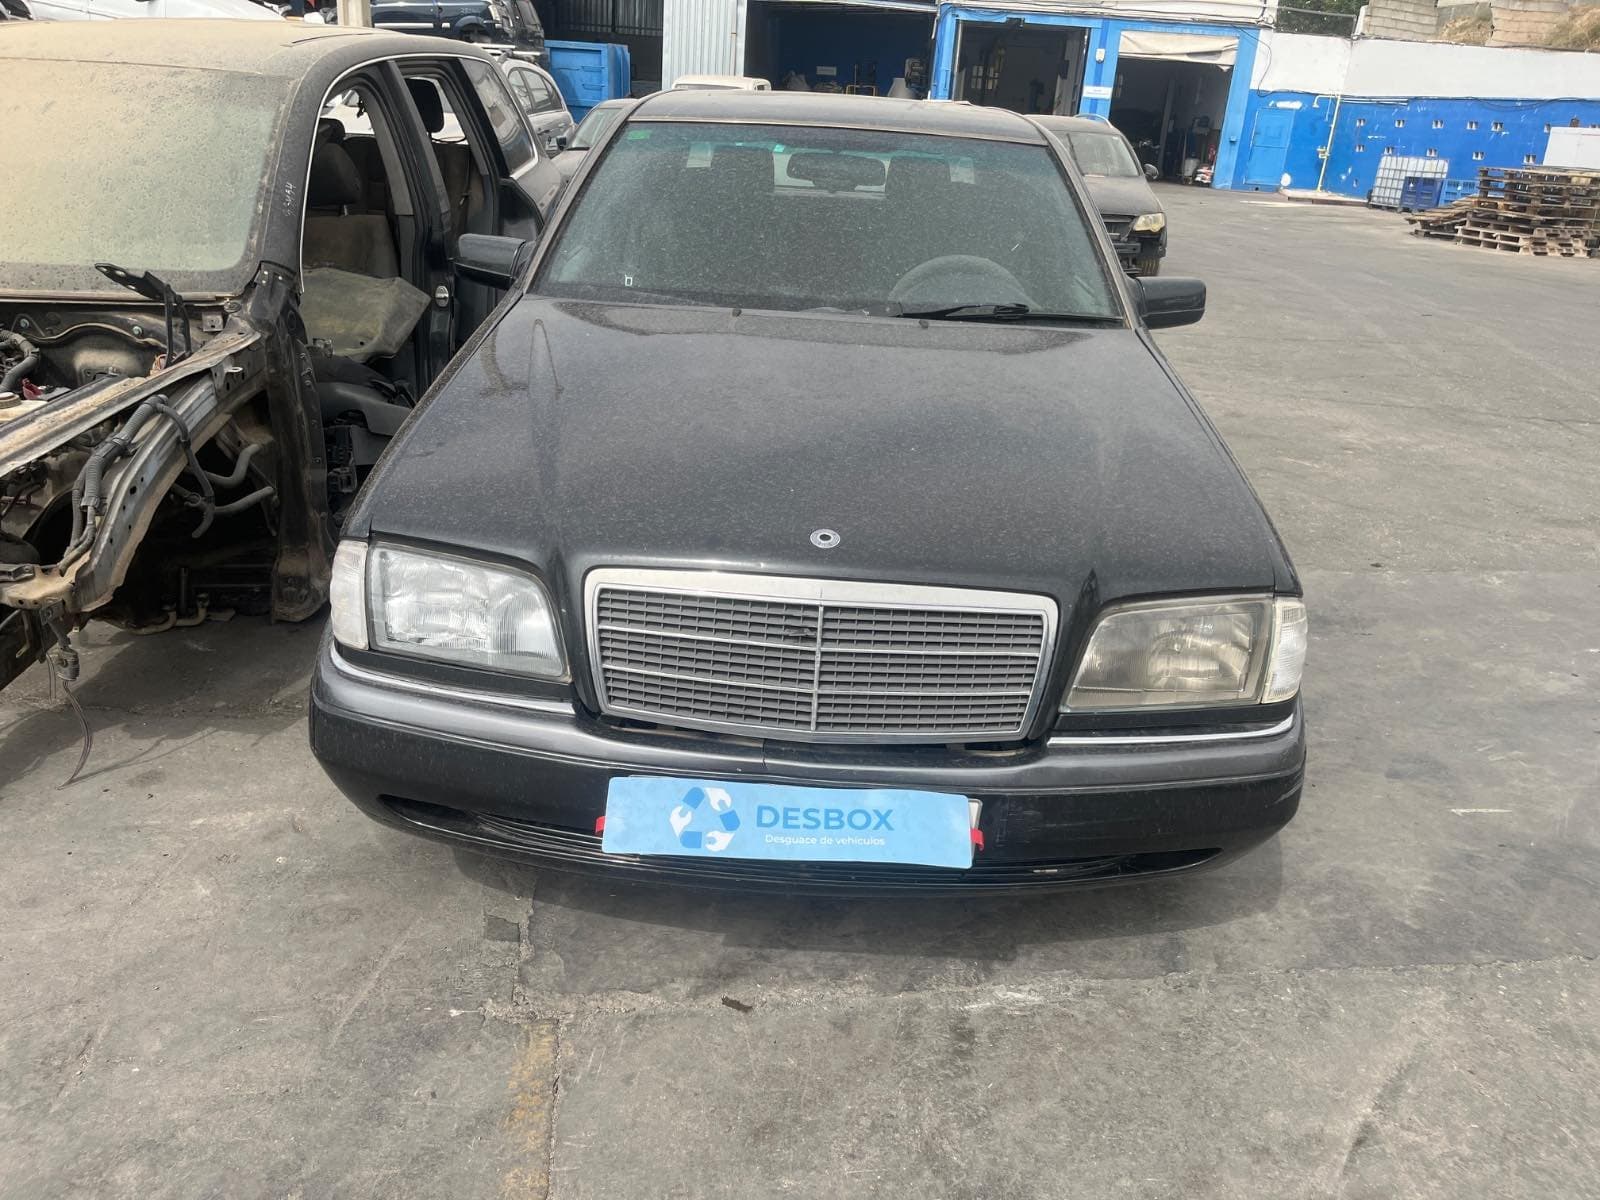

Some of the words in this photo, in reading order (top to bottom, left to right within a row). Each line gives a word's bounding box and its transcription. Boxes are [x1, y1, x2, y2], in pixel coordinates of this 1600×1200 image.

[756, 805, 894, 831] DESBOX
[765, 834, 817, 847] Desguace
[820, 835, 833, 846] de
